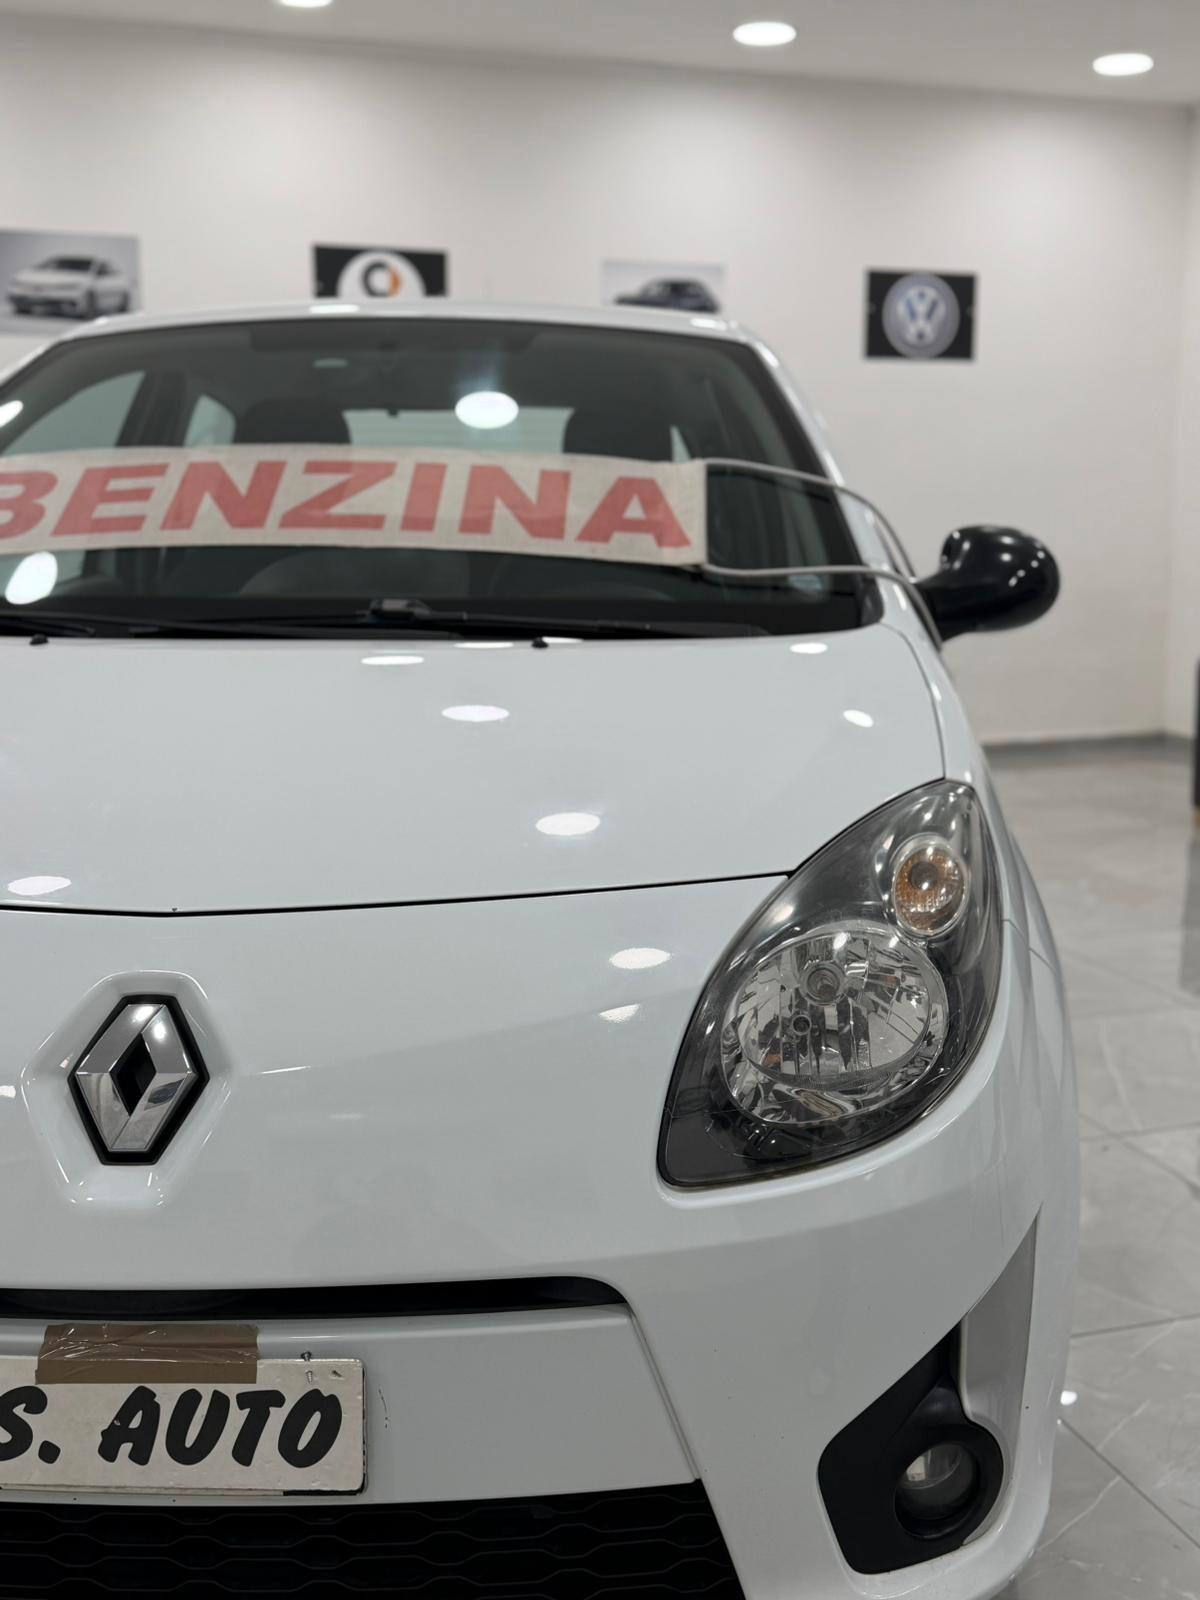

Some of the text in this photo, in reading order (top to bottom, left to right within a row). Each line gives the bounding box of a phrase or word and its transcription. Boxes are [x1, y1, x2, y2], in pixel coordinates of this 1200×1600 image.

[0, 461, 690, 546] BENZINA
[0, 1385, 343, 1468] S. AUTO
